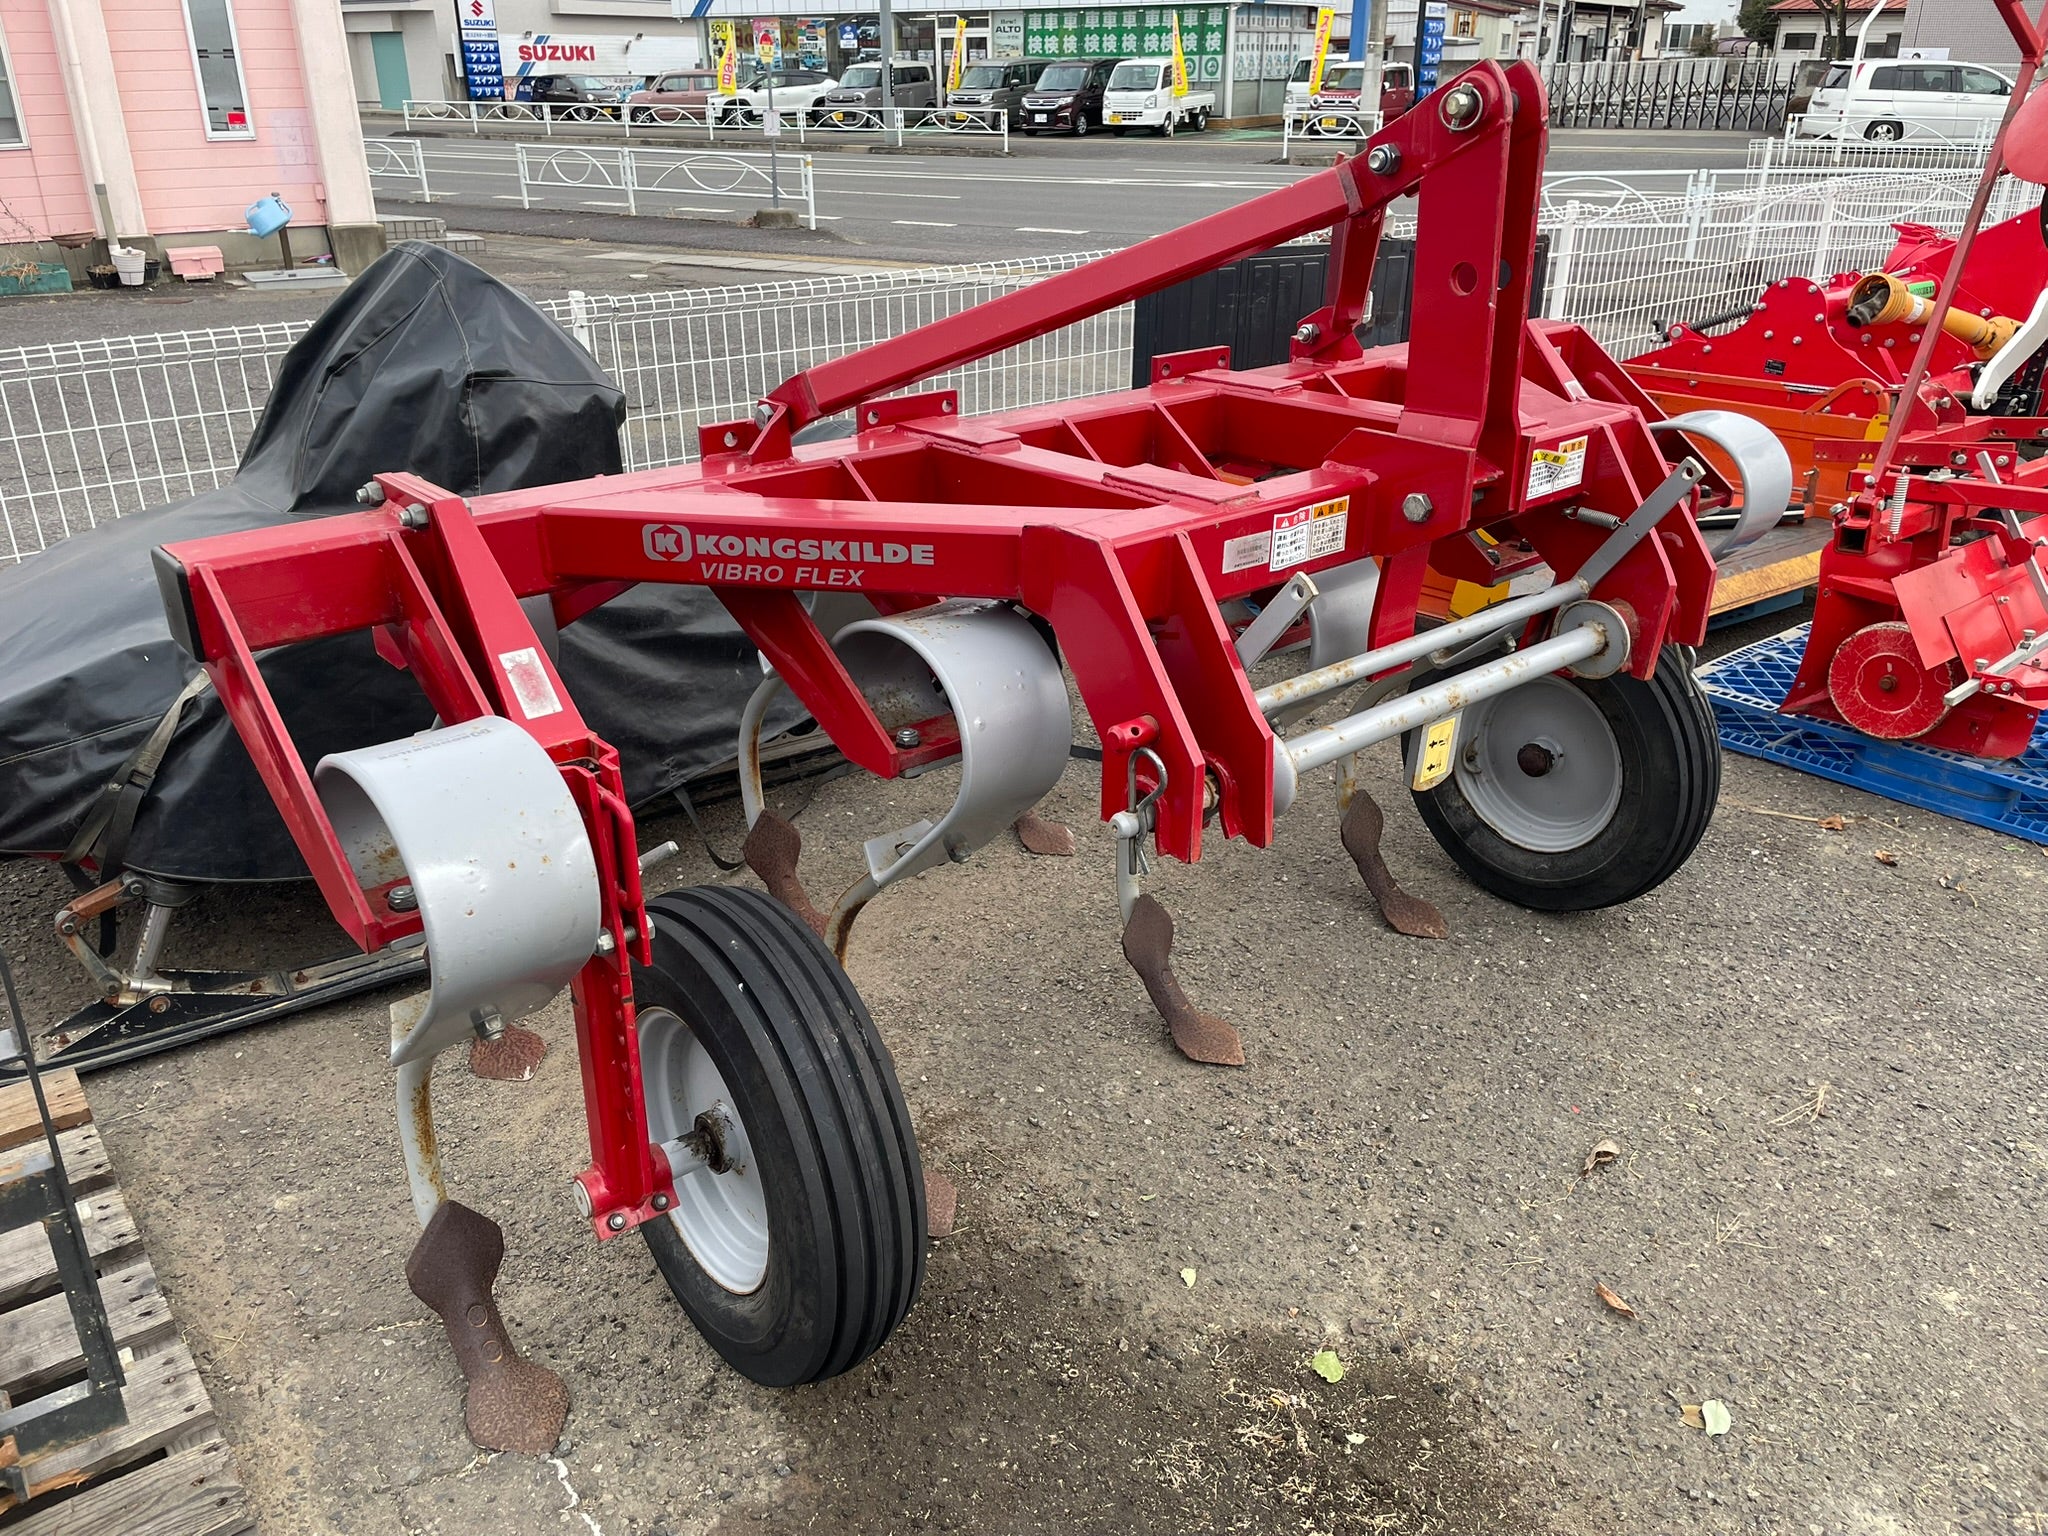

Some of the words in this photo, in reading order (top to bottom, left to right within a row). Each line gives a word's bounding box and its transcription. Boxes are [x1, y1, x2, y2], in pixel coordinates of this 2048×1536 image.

[470, 53, 496, 62] アルト
[518, 45, 595, 61] SUZUKI
[475, 76, 499, 85] スイフト
[476, 87, 500, 96] ソリオ
[1293, 511, 1306, 525] 危険
[697, 534, 935, 566] KONGSKILDE
[700, 562, 784, 583] VIBRO
[795, 566, 865, 587] FLEX
